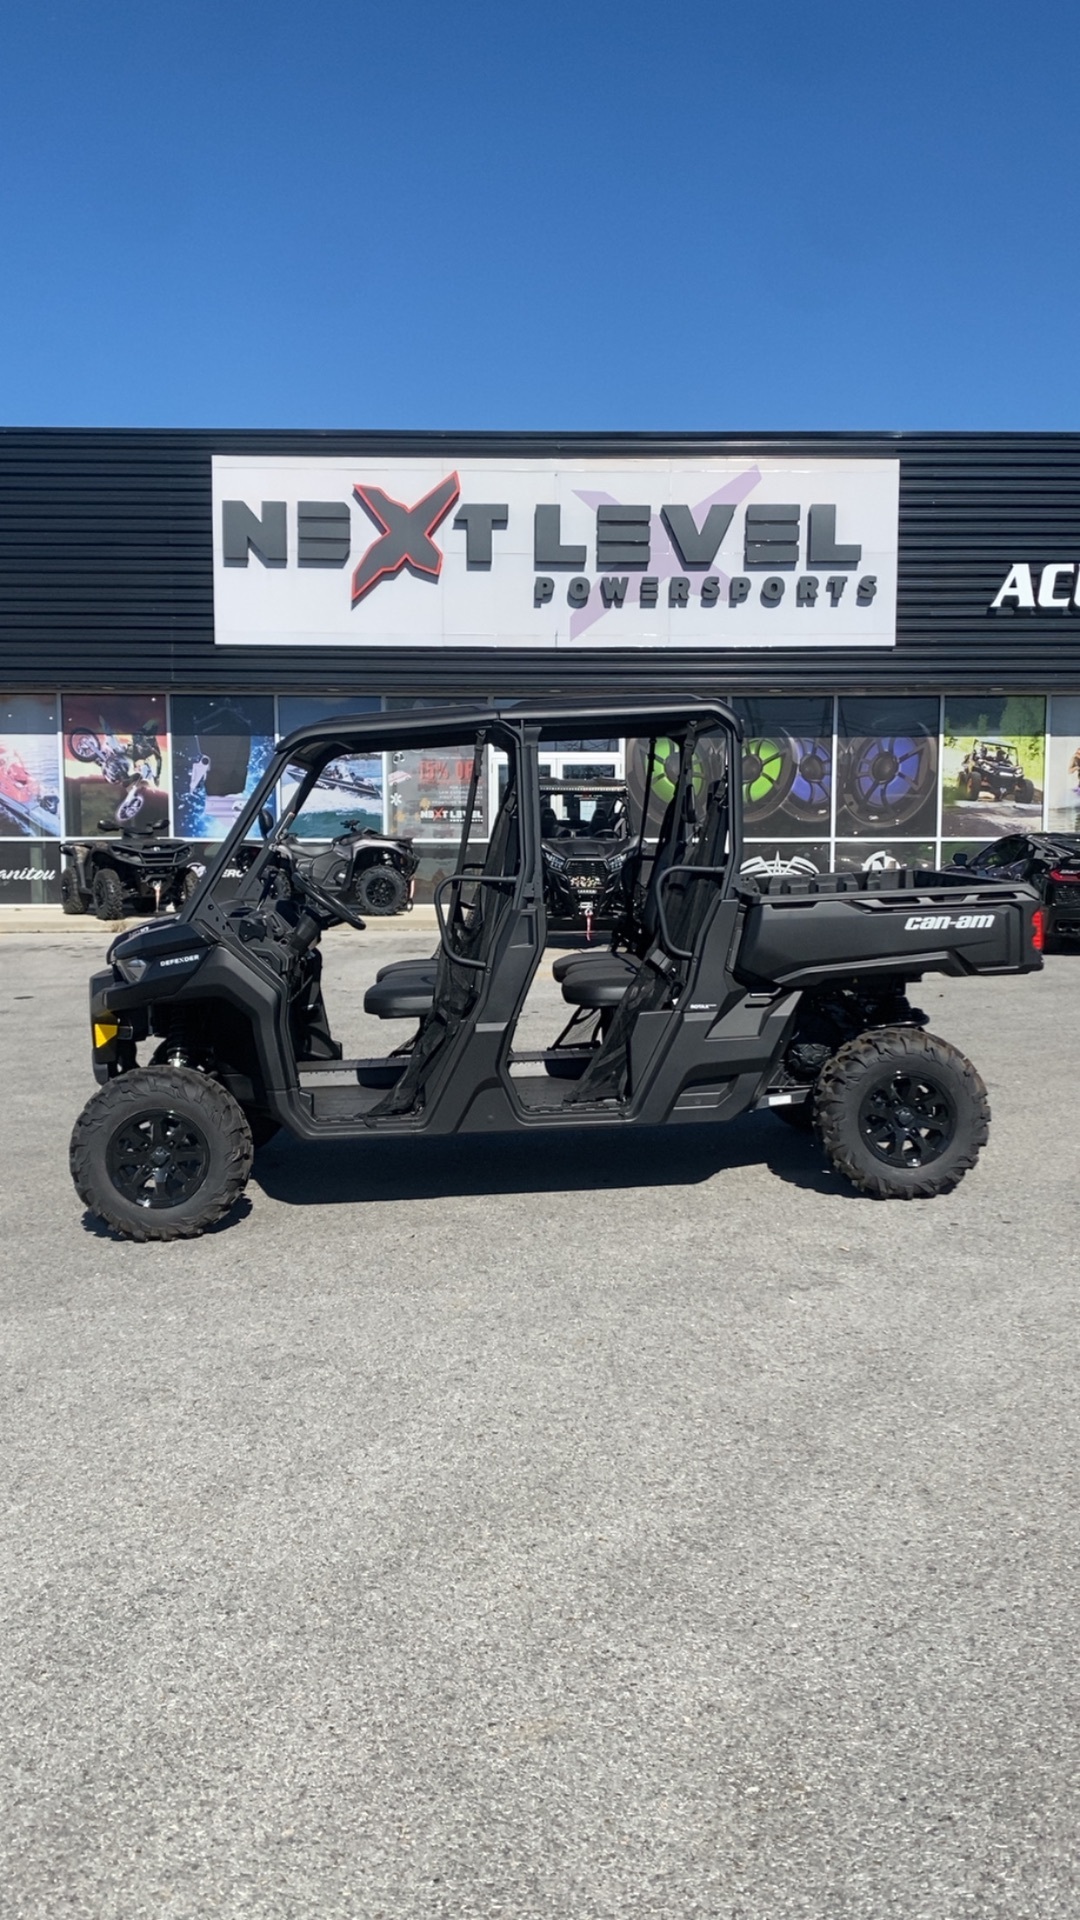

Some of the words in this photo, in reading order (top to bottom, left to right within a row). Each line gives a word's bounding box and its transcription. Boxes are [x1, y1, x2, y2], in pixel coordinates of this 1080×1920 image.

[222, 470, 508, 602] NEXT
[534, 504, 862, 567] LEVEL
[534, 575, 877, 606] POWERSPORTS
[990, 563, 1080, 607] AC
[420, 808, 448, 821] NEXT
[0, 866, 56, 881] anitou
[904, 914, 995, 931] can-am
[160, 954, 200, 967] DEFENDER
